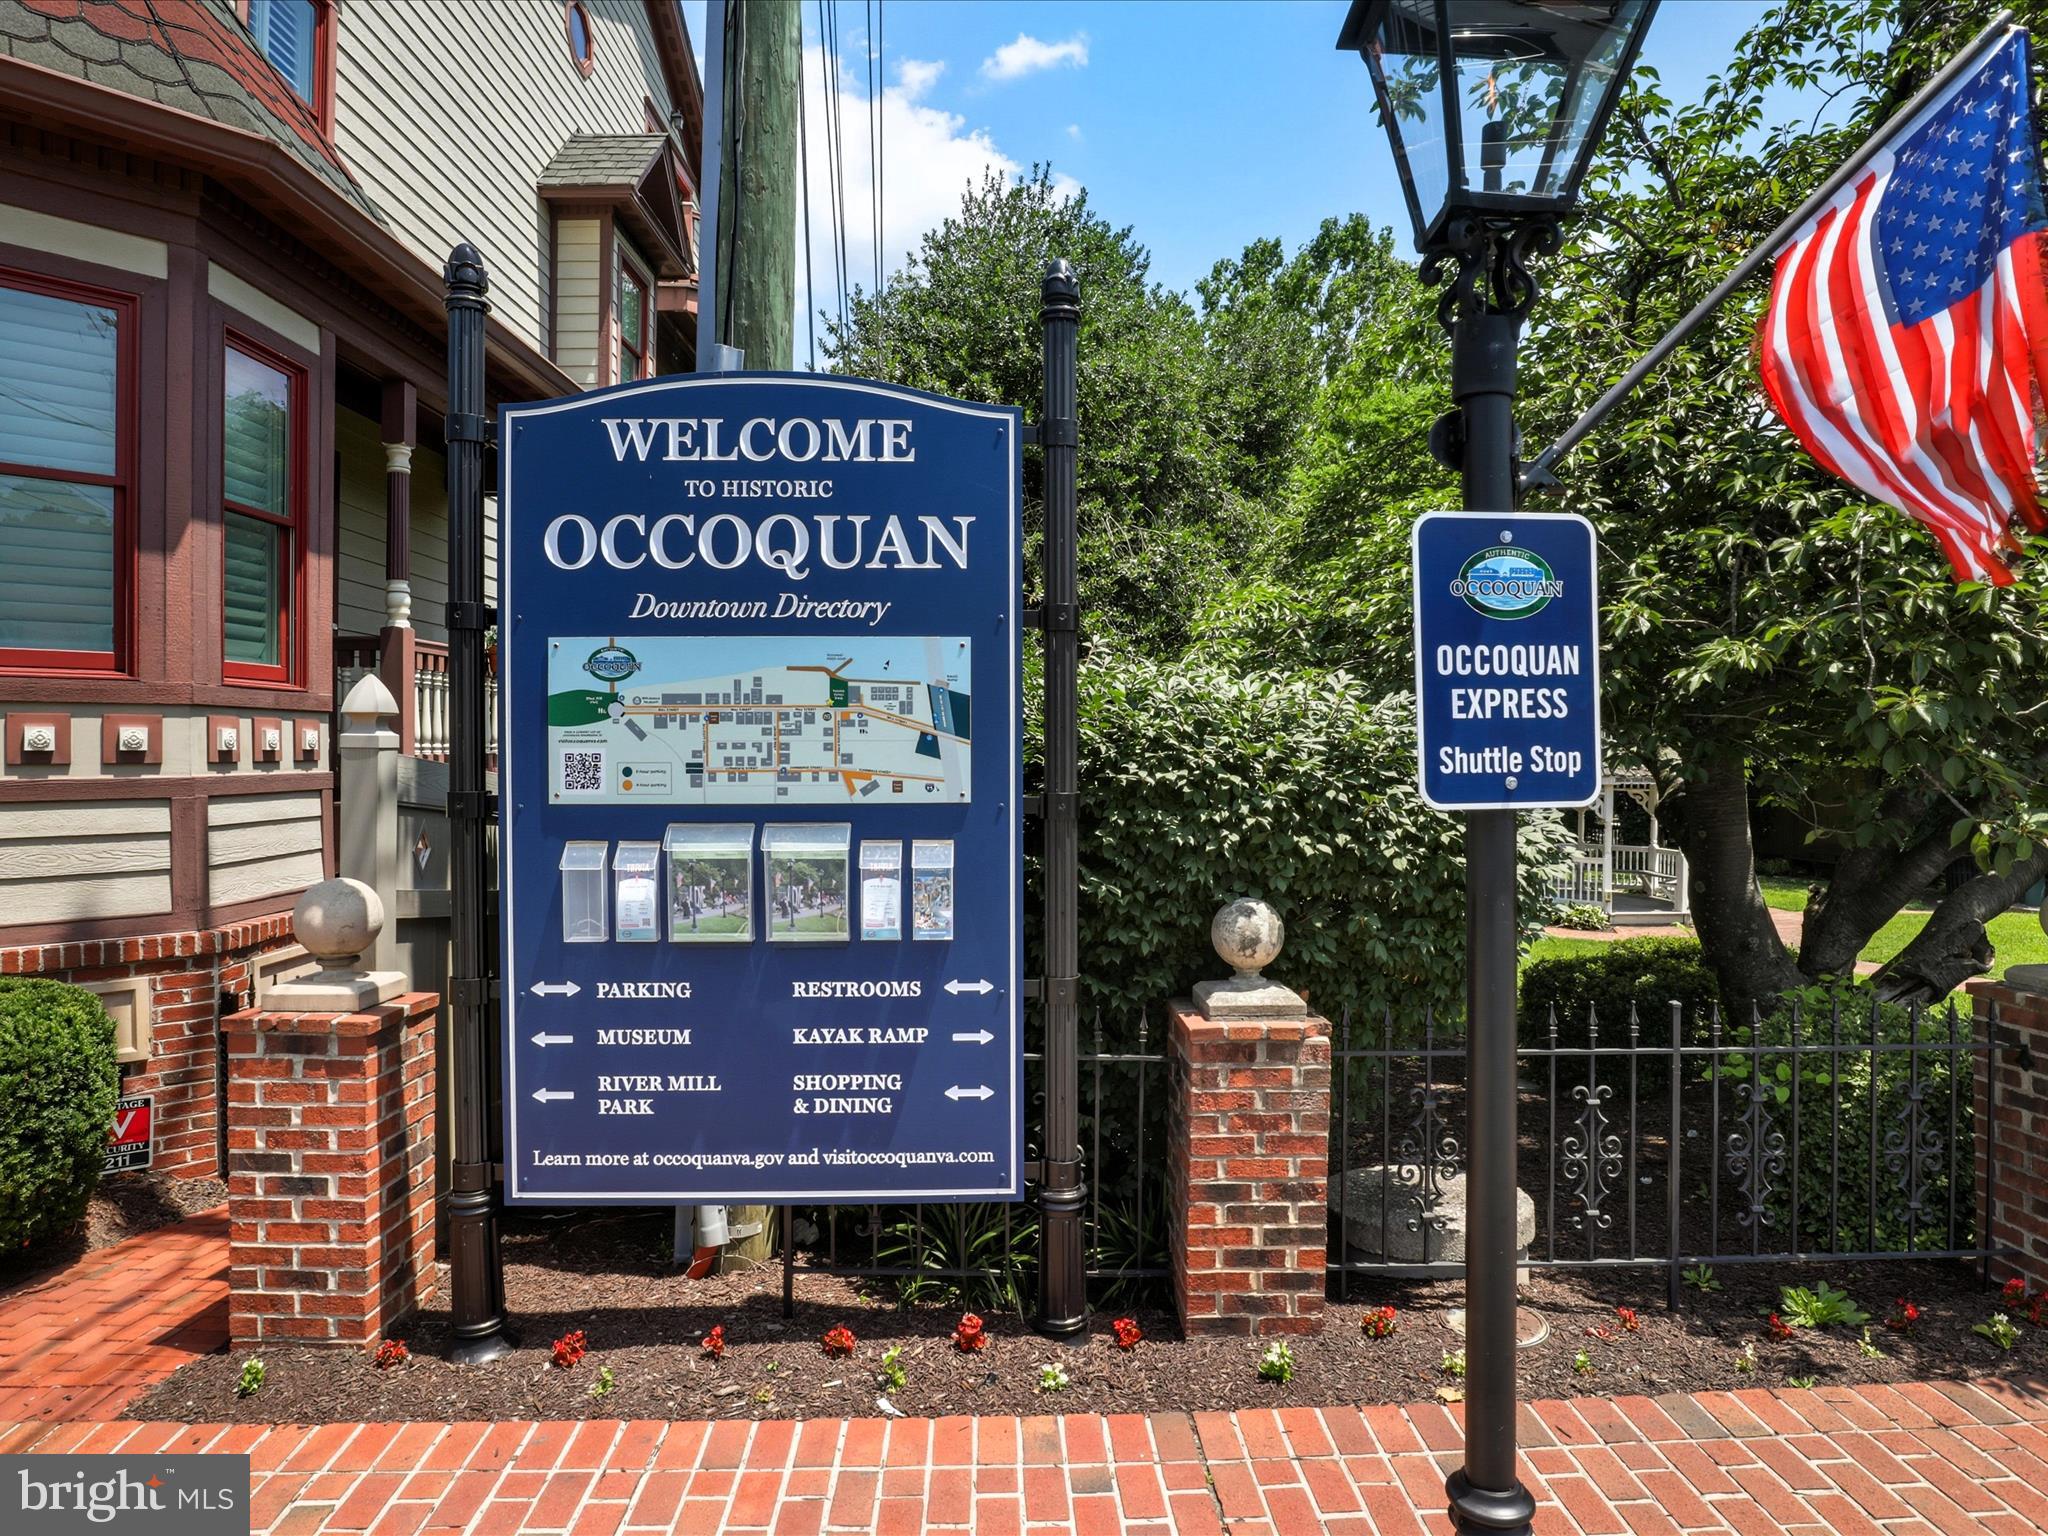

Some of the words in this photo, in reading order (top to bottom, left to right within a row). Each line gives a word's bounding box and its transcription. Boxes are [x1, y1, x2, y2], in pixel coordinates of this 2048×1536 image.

[601, 418, 916, 463] WELCOME
[685, 480, 715, 498] TO
[722, 480, 833, 498] HISTORIC
[543, 513, 977, 581] OCCOQUAN
[1485, 548, 1531, 560] AUTHENTIC
[1449, 578, 1564, 600] OCCOQUAN
[628, 593, 768, 619] Downtown
[771, 593, 891, 626] Directory
[1436, 644, 1580, 678] OCCOQUAN
[1451, 687, 1569, 719] EXPRESS
[1439, 745, 1523, 775] Shuttle
[1530, 745, 1582, 778] Stop
[596, 982, 692, 999] PARKING
[792, 980, 922, 998] RESTROOMS
[596, 1028, 692, 1046] MUSEUM
[792, 1027, 864, 1045] KAYAK
[867, 1027, 929, 1044] RAMP
[597, 1075, 664, 1092] RIVER
[668, 1075, 722, 1092] MILL
[793, 1073, 903, 1091] SHOPPING
[117, 1099, 145, 1110] TAGE
[598, 1098, 655, 1115] PARK
[793, 1097, 810, 1114] &
[814, 1097, 893, 1114] DINING
[106, 1141, 145, 1155] CURITY
[533, 1149, 582, 1166] Learn
[585, 1154, 630, 1166] more
[632, 1151, 650, 1166] at
[653, 1153, 784, 1170] occoquanva.gov
[788, 1148, 820, 1166] and
[822, 1148, 995, 1169] visitoccoquanva.com
